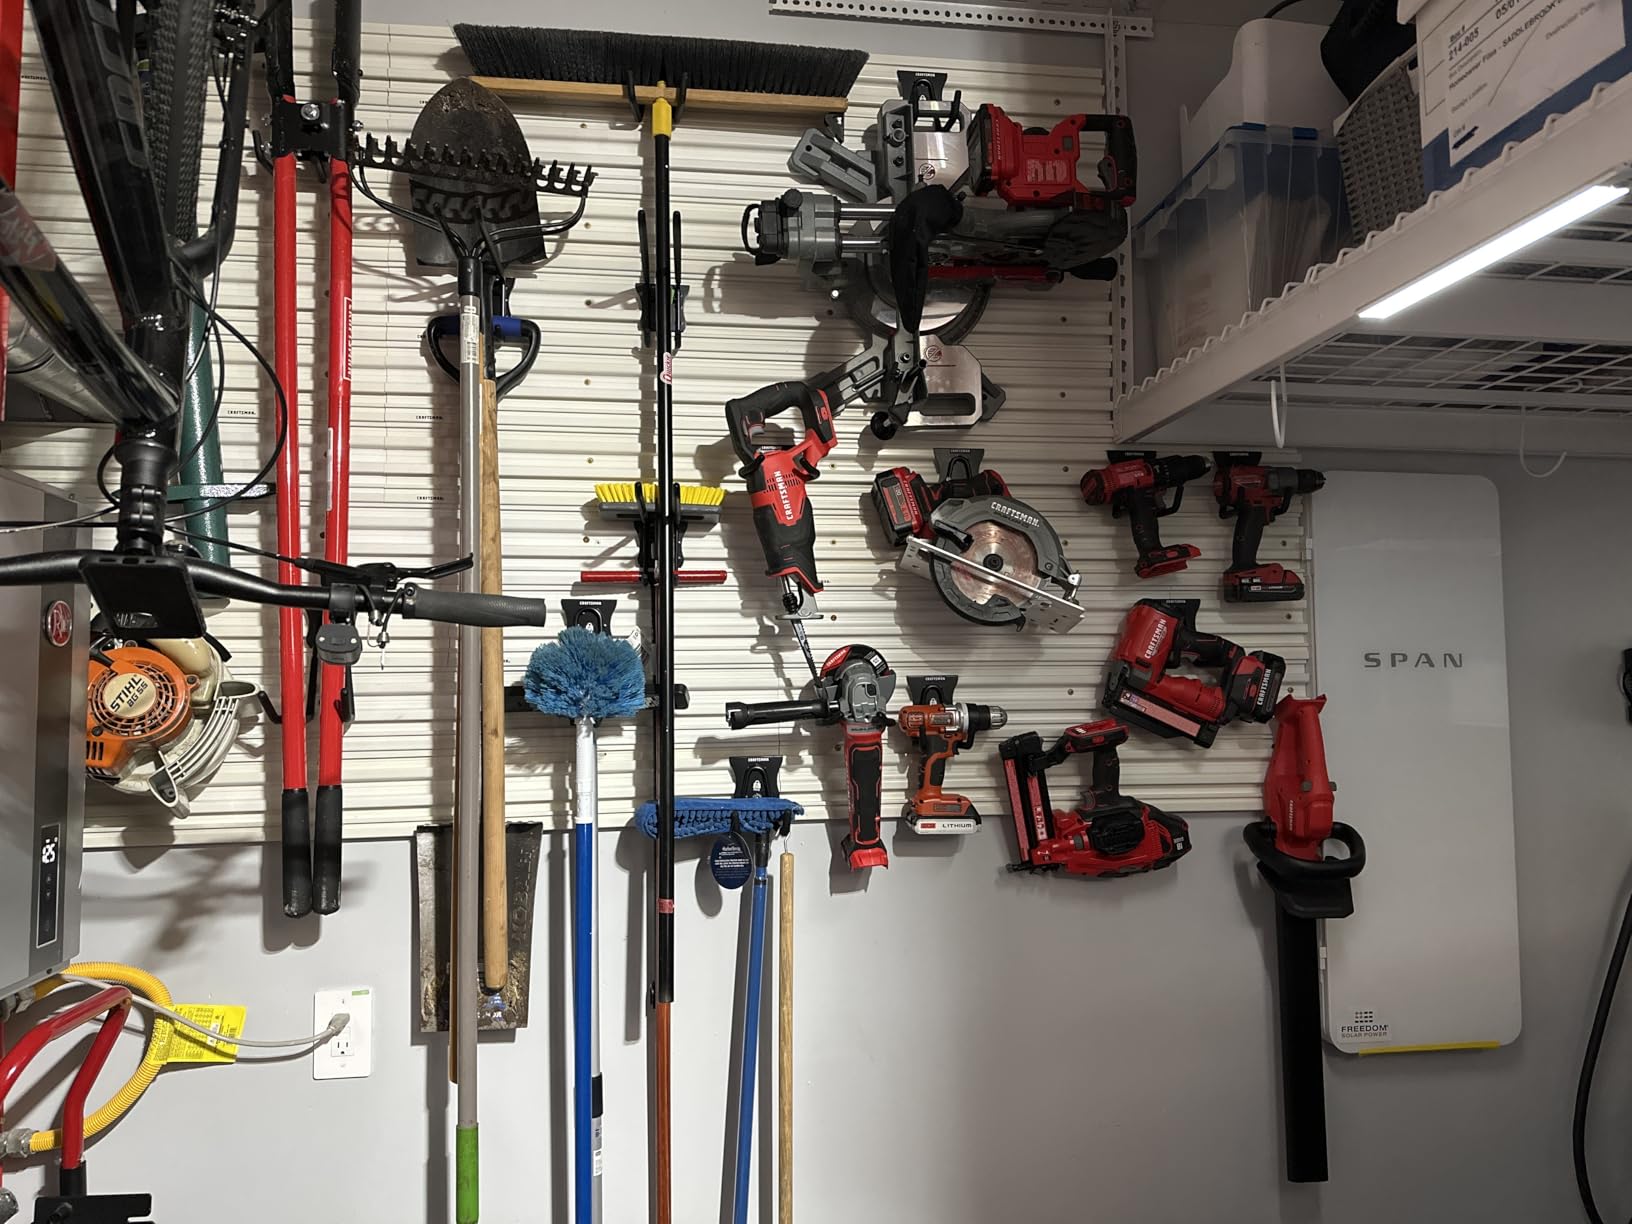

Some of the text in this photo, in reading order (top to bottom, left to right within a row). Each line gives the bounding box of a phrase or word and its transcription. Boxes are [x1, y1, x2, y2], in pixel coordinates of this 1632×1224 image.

[1449, 27, 1479, 60] 214-005
[774, 470, 794, 520] CRAFTSMAN
[990, 501, 1041, 528] CRAFTSMAN
[1144, 618, 1167, 659] CRAFTSMAN
[1364, 652, 1463, 668] SPAN
[110, 677, 142, 712] STIHL
[1256, 668, 1272, 706] CRAFTSMAN
[1341, 1024, 1388, 1032] FREEDOM
